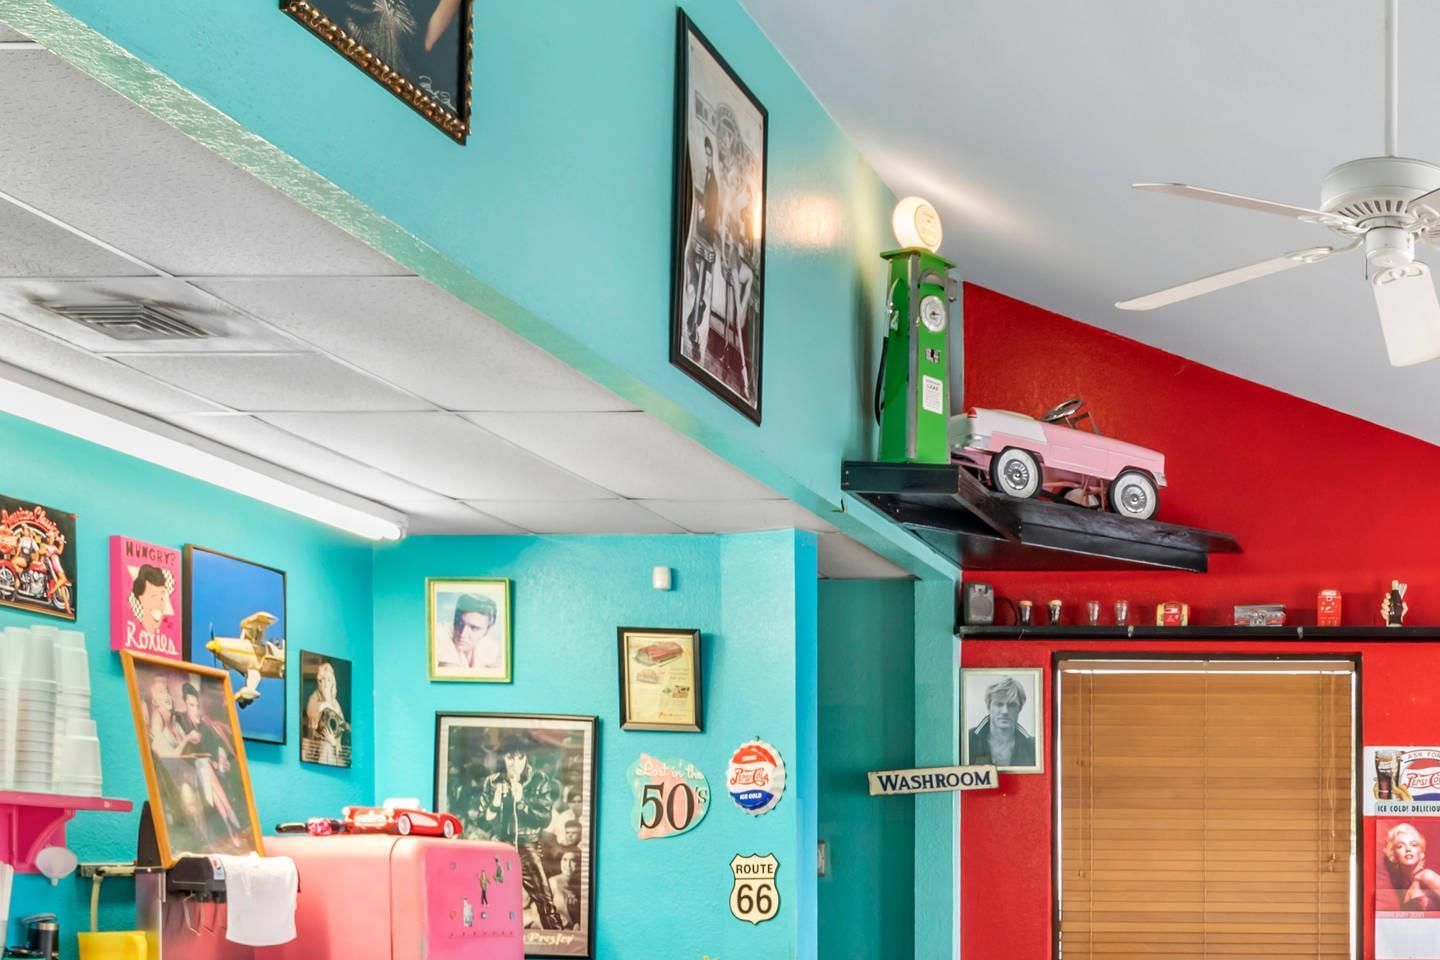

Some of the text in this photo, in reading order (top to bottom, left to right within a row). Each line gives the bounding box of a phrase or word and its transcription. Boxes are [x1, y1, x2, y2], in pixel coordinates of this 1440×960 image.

[125, 541, 176, 565] HUNGRY?
[125, 620, 179, 655] Roxies
[877, 770, 991, 793] WASHROOM
[640, 781, 707, 831] 50's
[1377, 805, 1387, 813] ICE
[736, 863, 774, 875] ROUTE
[736, 883, 773, 915] 66
